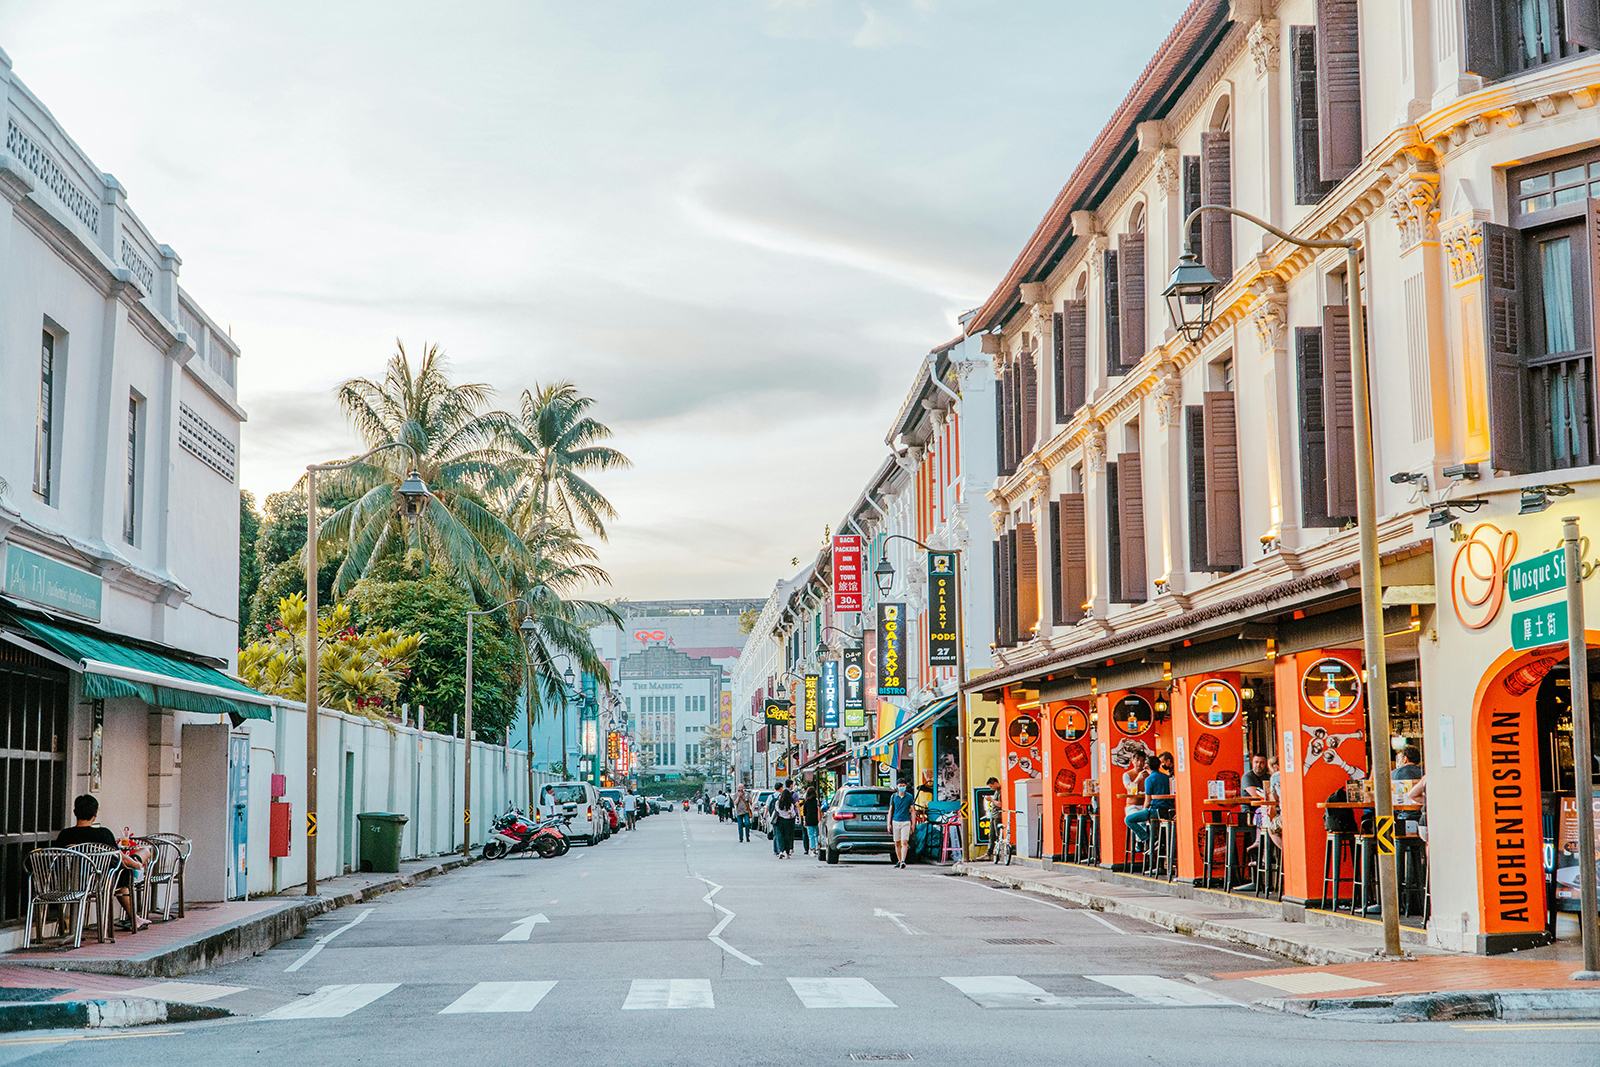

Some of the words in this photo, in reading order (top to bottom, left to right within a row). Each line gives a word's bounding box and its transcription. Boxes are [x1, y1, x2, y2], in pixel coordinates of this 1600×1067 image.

[1450, 522, 1469, 543] The
[1513, 564, 1551, 591] Mosque
[1553, 554, 1566, 579] St
[840, 596, 856, 604] 30A
[938, 579, 947, 629] GALAXY
[885, 621, 898, 676] GALAXY
[937, 648, 950, 656] 27
[884, 677, 900, 686] 28
[1371, 664, 1378, 678] 1
[825, 662, 836, 714] VICTORIA
[973, 717, 1000, 737] 27
[1491, 711, 1529, 923] AUCHENTOSHAN
